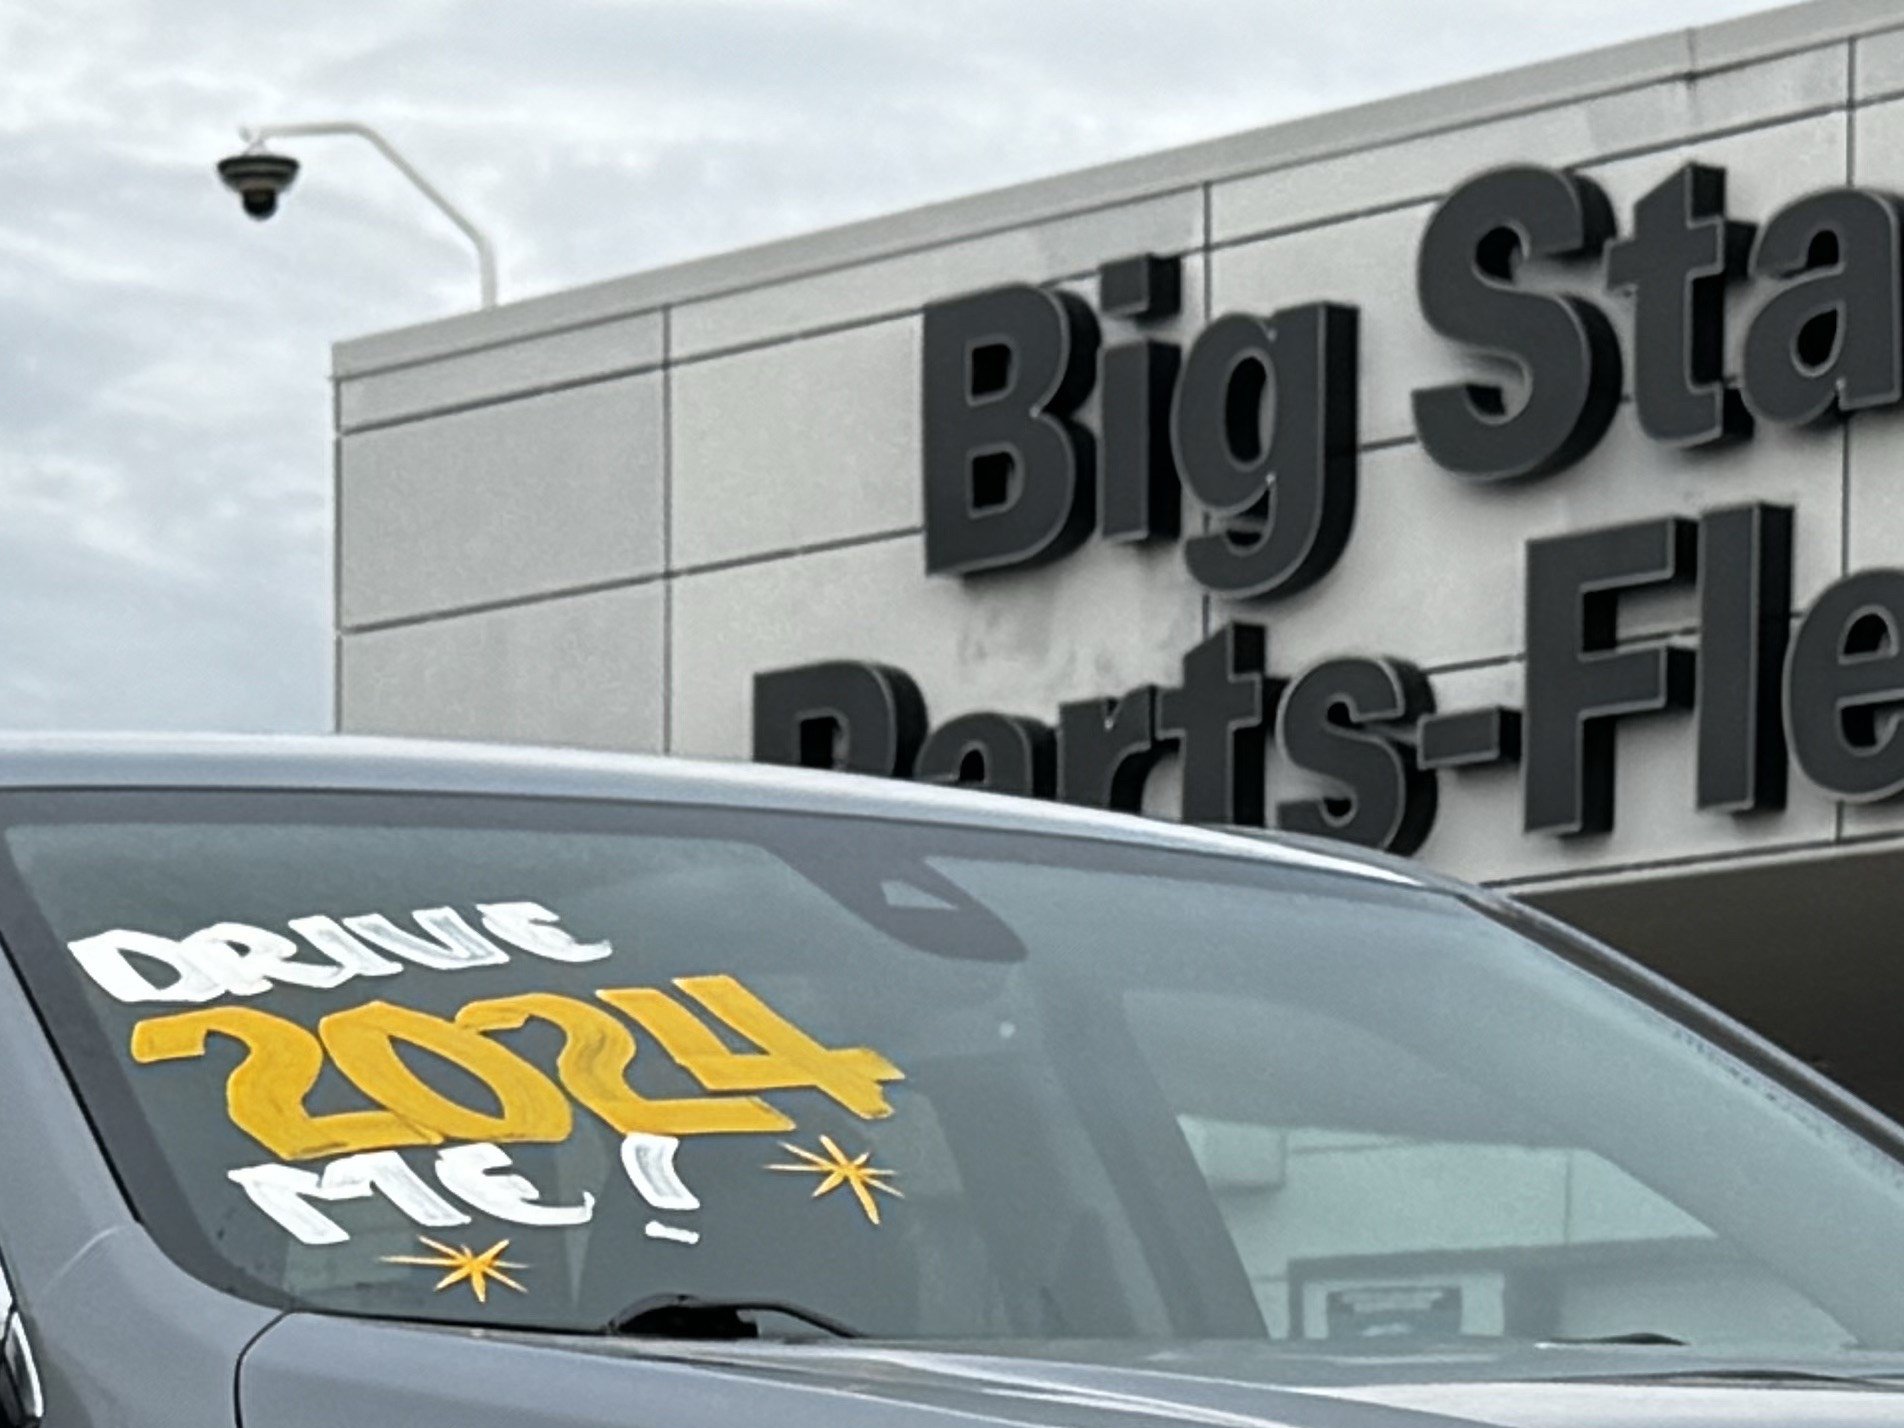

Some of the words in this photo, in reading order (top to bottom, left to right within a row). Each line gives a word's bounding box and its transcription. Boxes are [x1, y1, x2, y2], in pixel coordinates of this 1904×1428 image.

[918, 252, 1361, 602] Big
[67, 901, 614, 1003] DRIVE
[130, 974, 906, 1161] 2024
